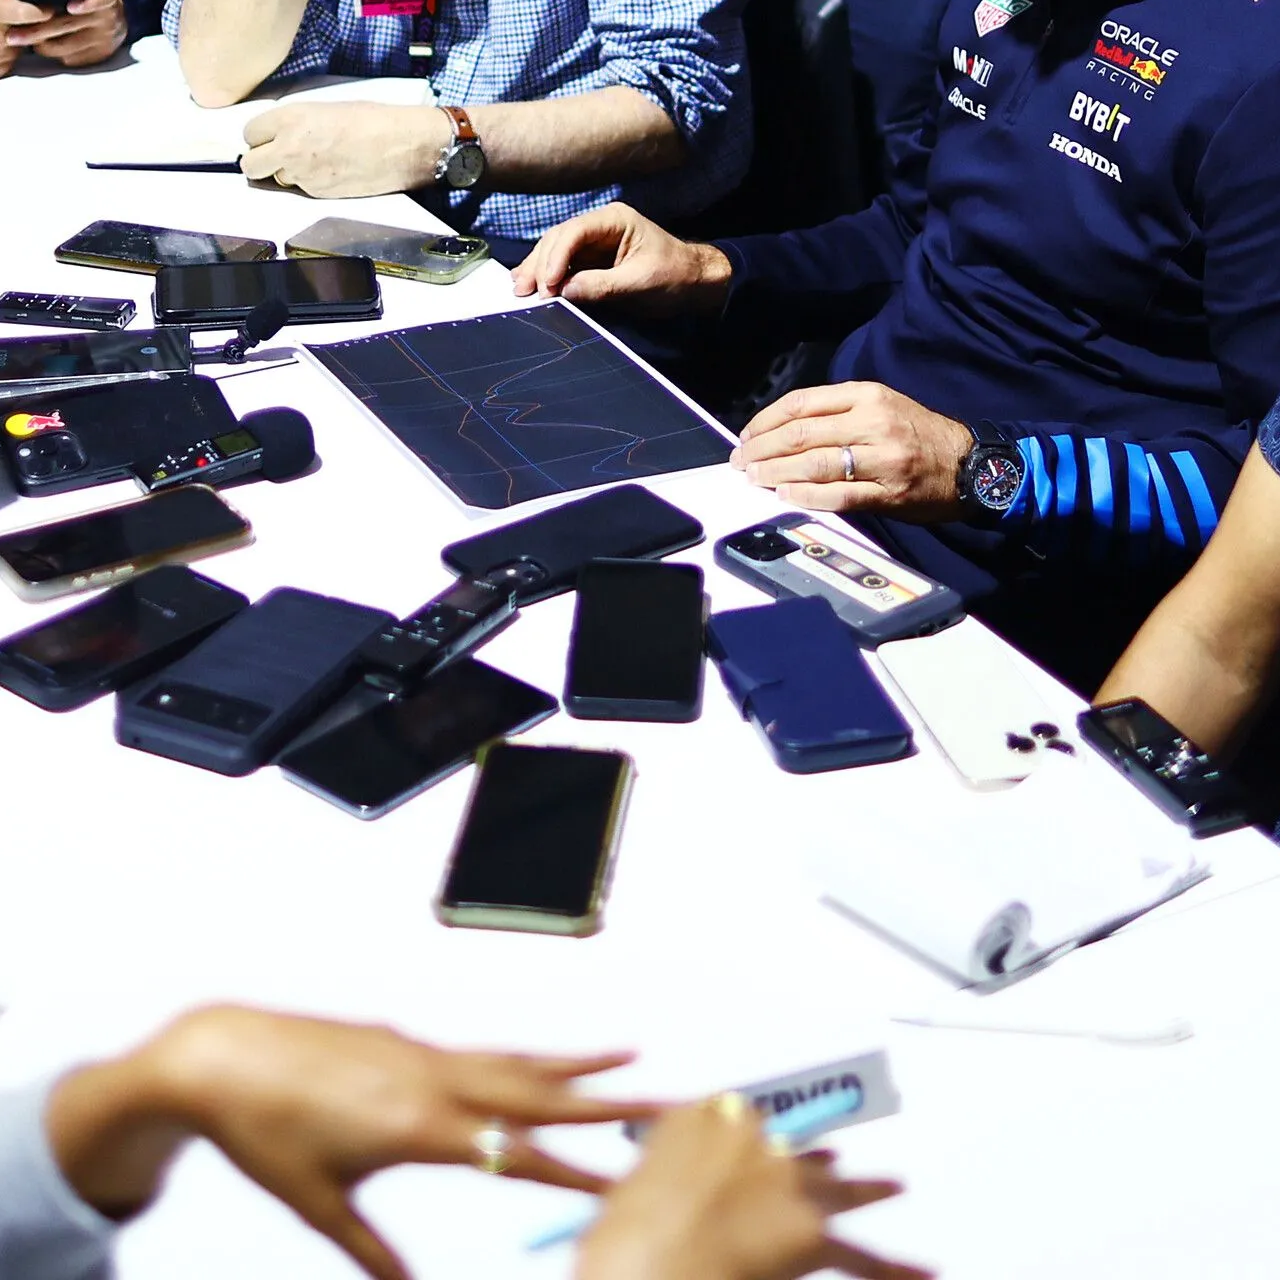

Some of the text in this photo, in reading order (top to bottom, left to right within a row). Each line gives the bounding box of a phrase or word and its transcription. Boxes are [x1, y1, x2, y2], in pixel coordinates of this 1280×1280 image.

[977, 2, 1013, 33] HEUER
[1101, 20, 1179, 66] ORACLE
[1086, 61, 1154, 101] RACING
[948, 87, 986, 120] ORACLE
[1069, 91, 1131, 142] BYBIT
[1049, 133, 1122, 182] HONDA
